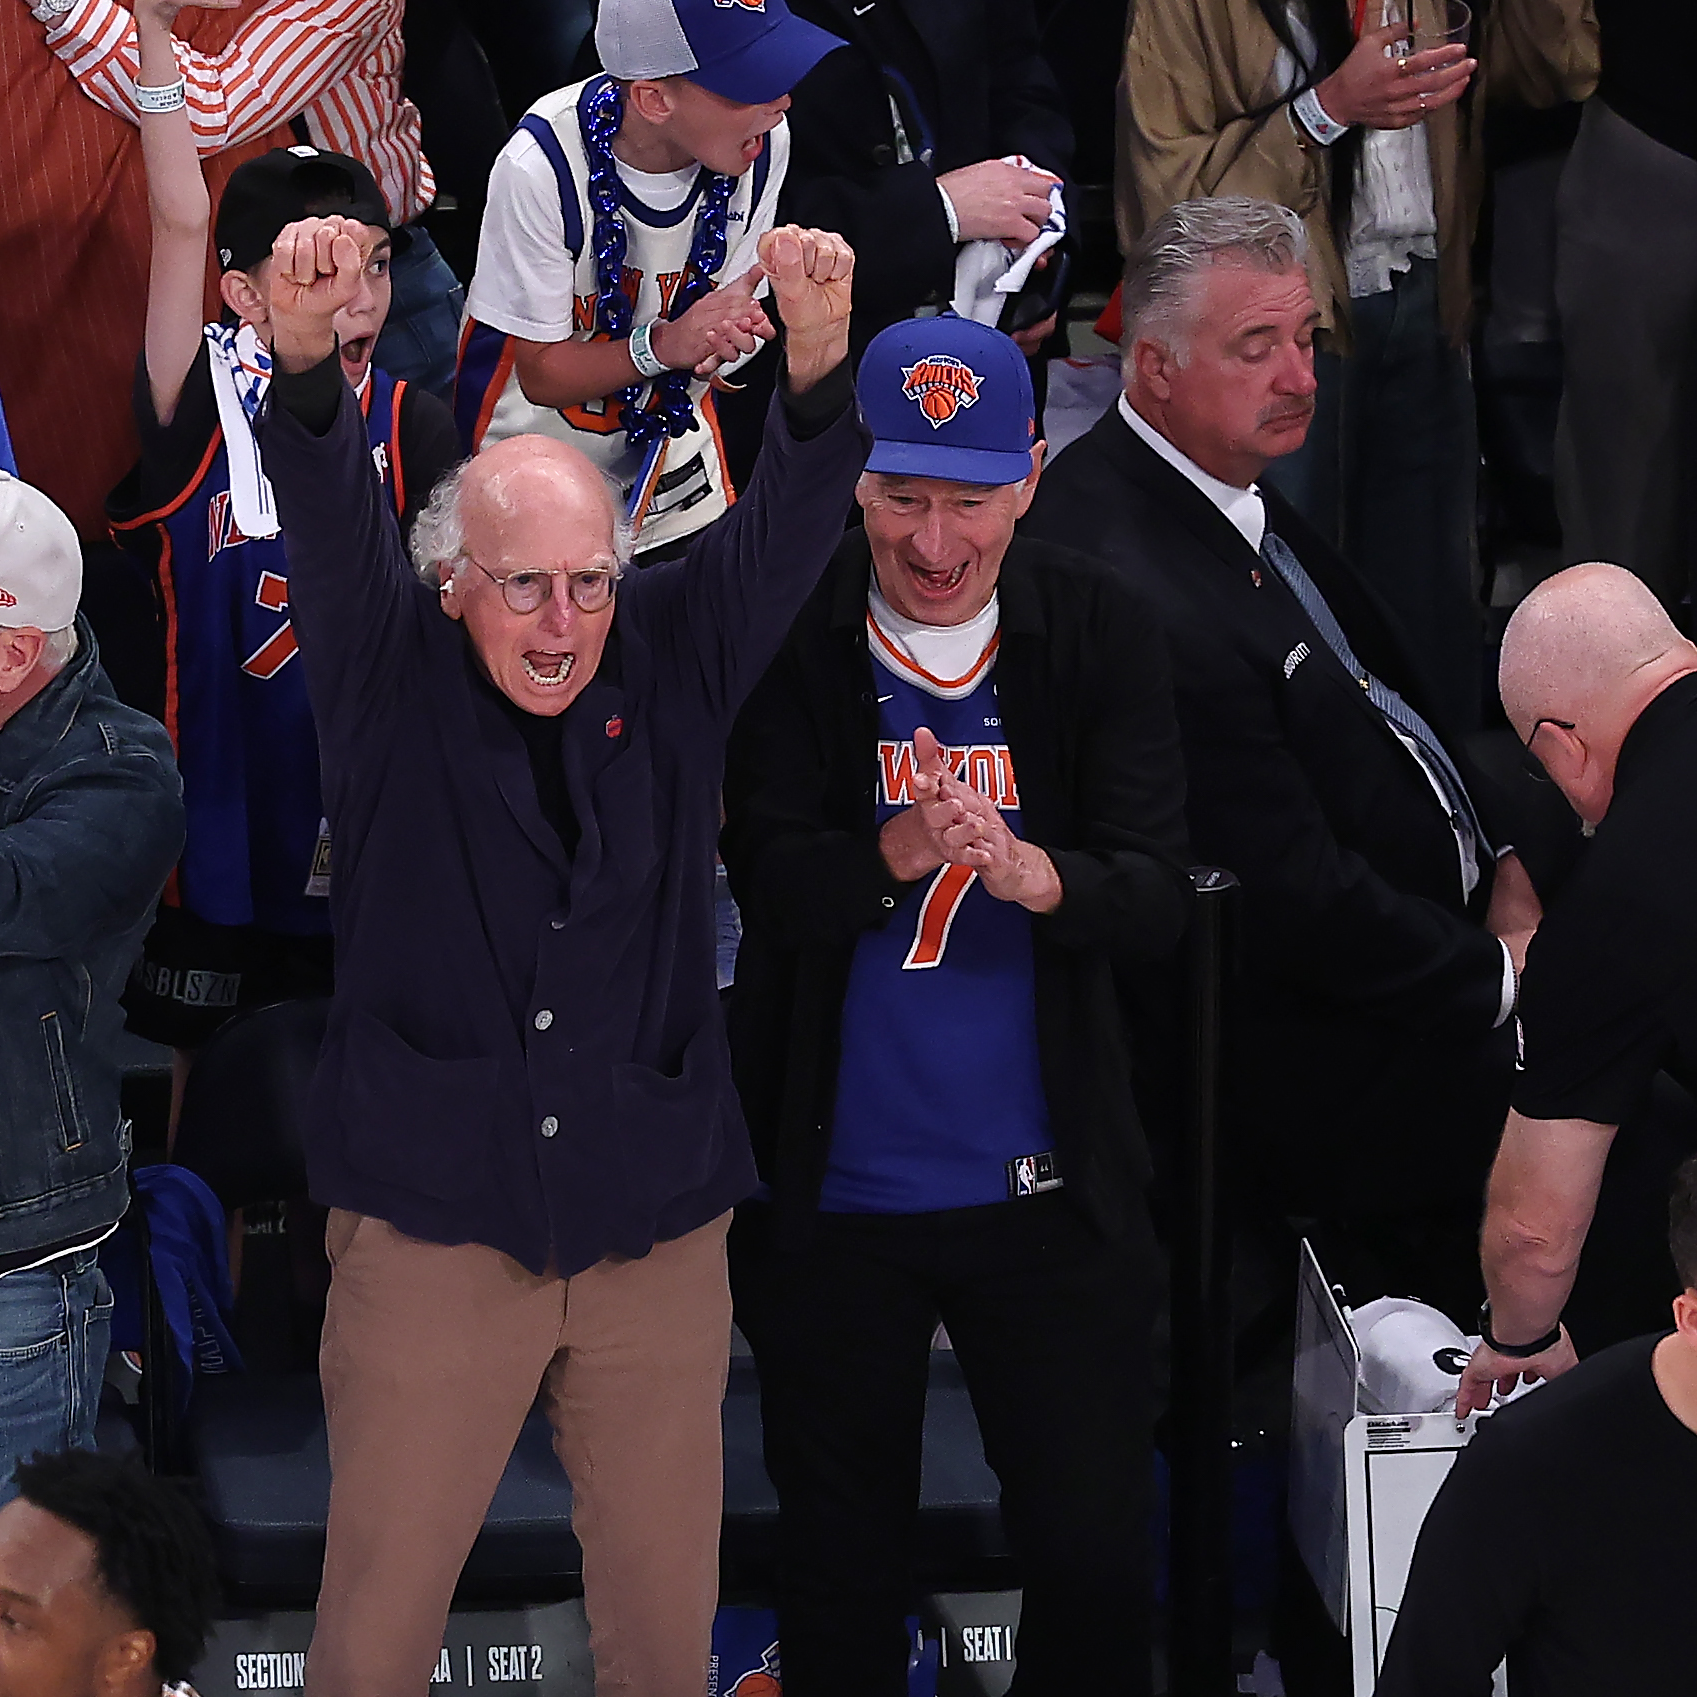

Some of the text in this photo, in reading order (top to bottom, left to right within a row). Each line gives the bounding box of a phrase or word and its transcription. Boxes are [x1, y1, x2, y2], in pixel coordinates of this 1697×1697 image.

[904, 363, 977, 398] KNICKS
[962, 1625, 1012, 1662] SEAT 1
[235, 1652, 306, 1690] SECTION
[488, 1645, 527, 1682] SEAT
[531, 1644, 543, 1680] 2
